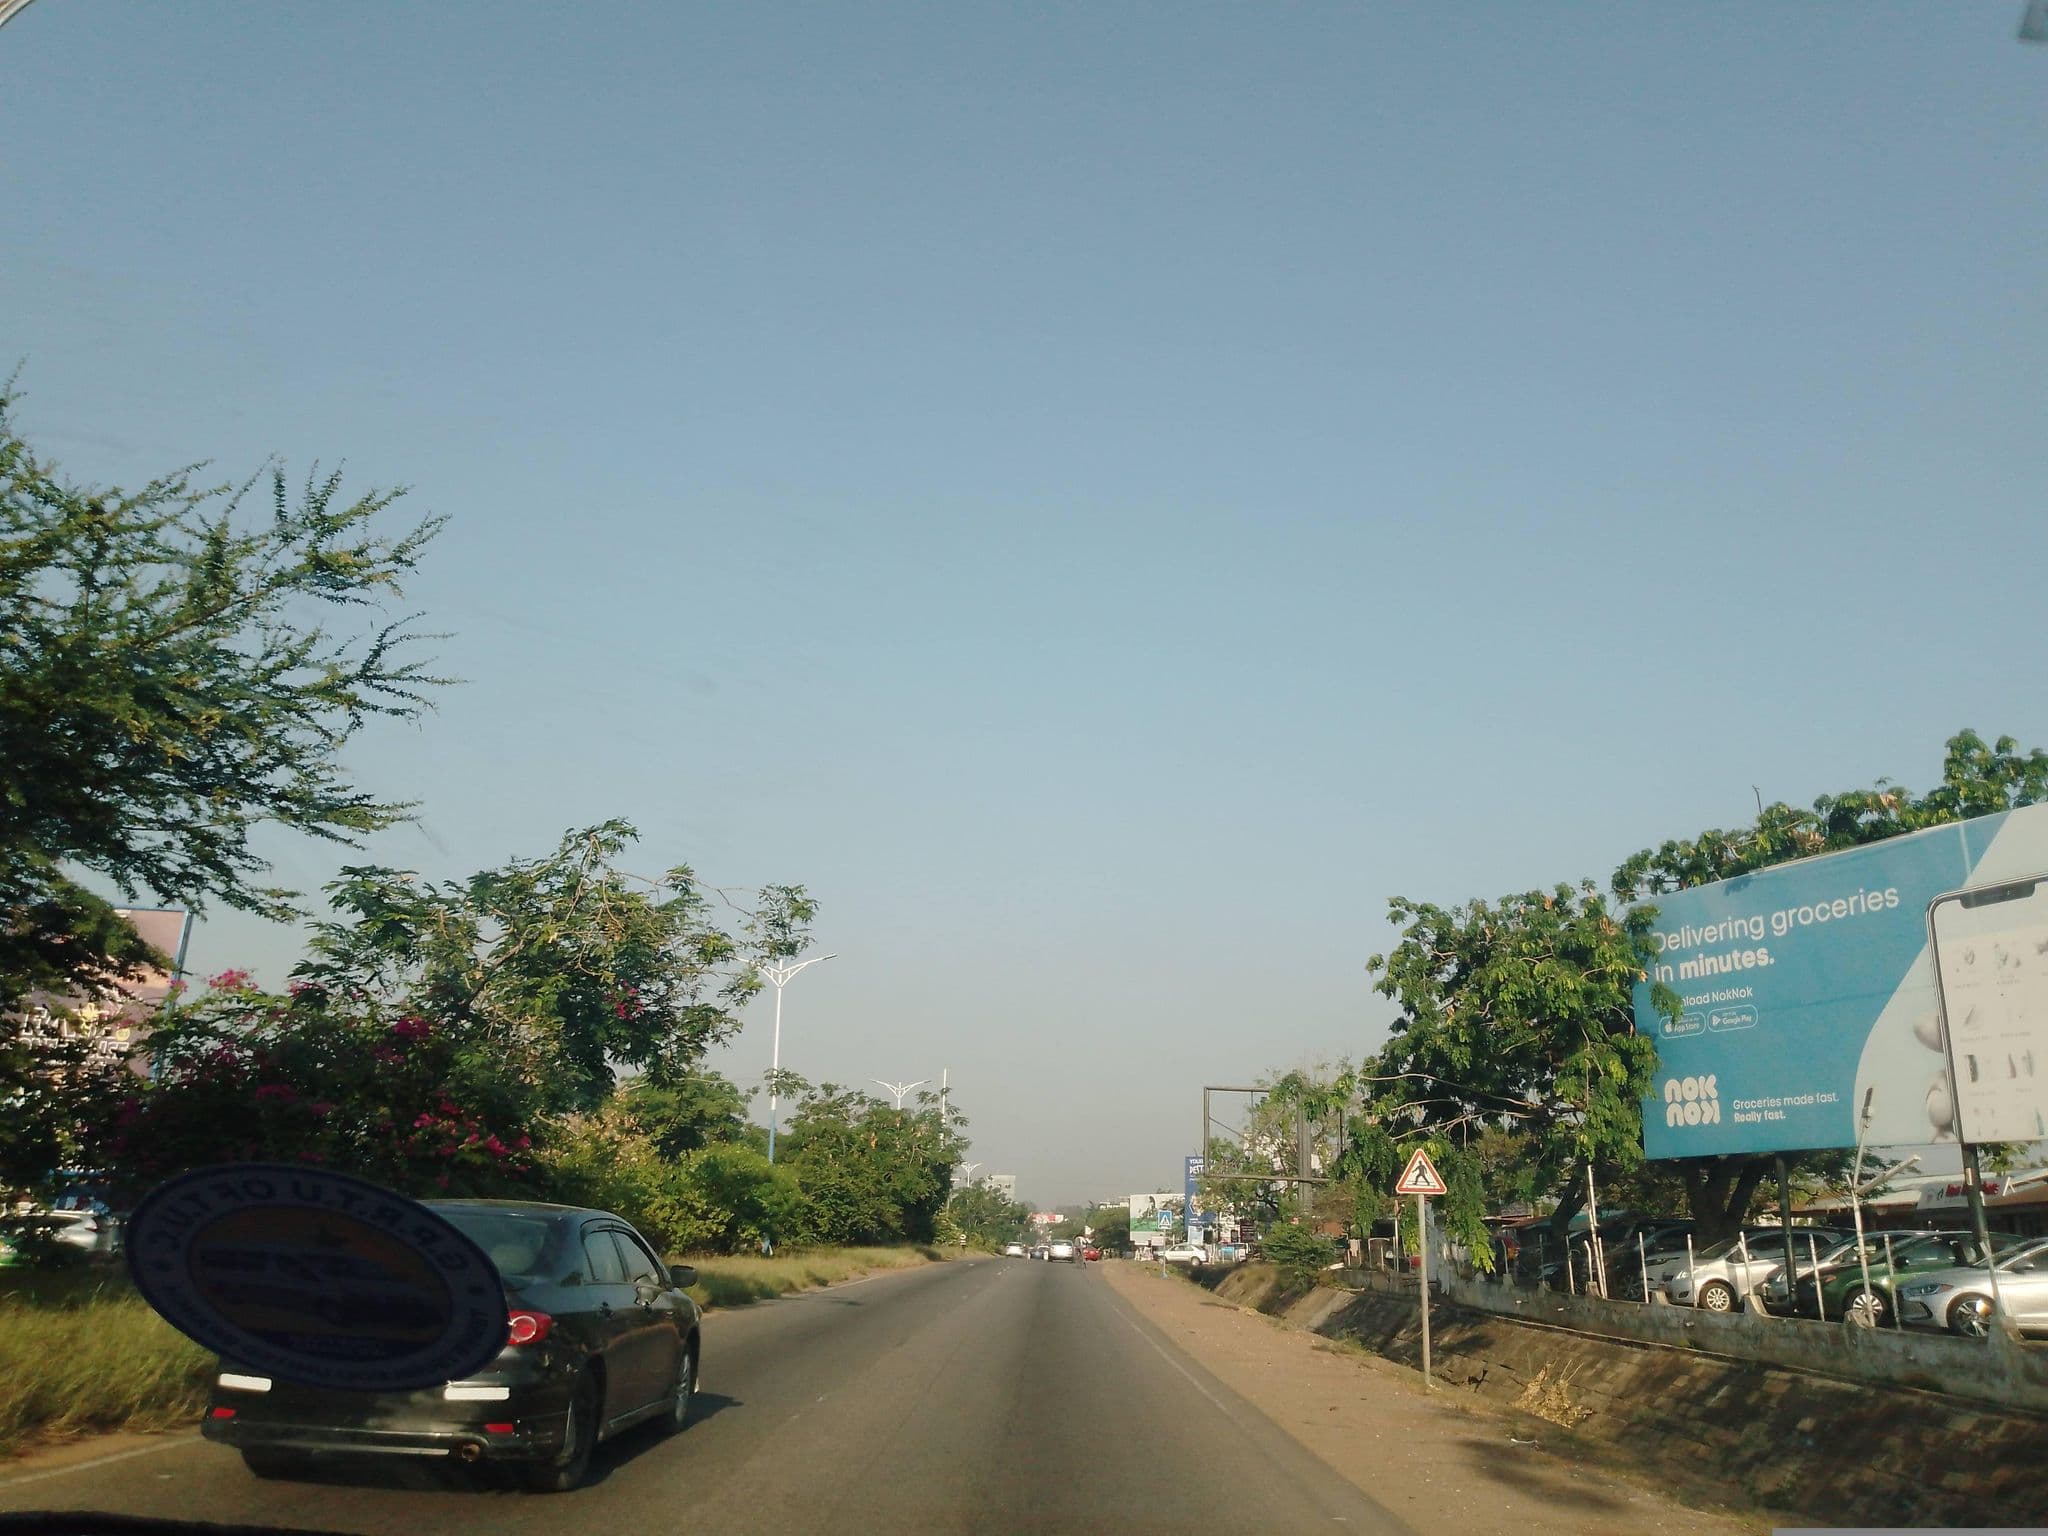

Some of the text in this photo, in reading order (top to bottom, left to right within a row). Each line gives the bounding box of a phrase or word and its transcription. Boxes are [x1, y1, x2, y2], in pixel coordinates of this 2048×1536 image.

[1653, 888, 1900, 953] Delivering groceries
[1655, 947, 1775, 983] in minutes.
[1711, 986, 1753, 1002] NokNok
[1733, 1091, 1840, 1111] Groceries made fast.
[1734, 1109, 1786, 1124] Really fast.
